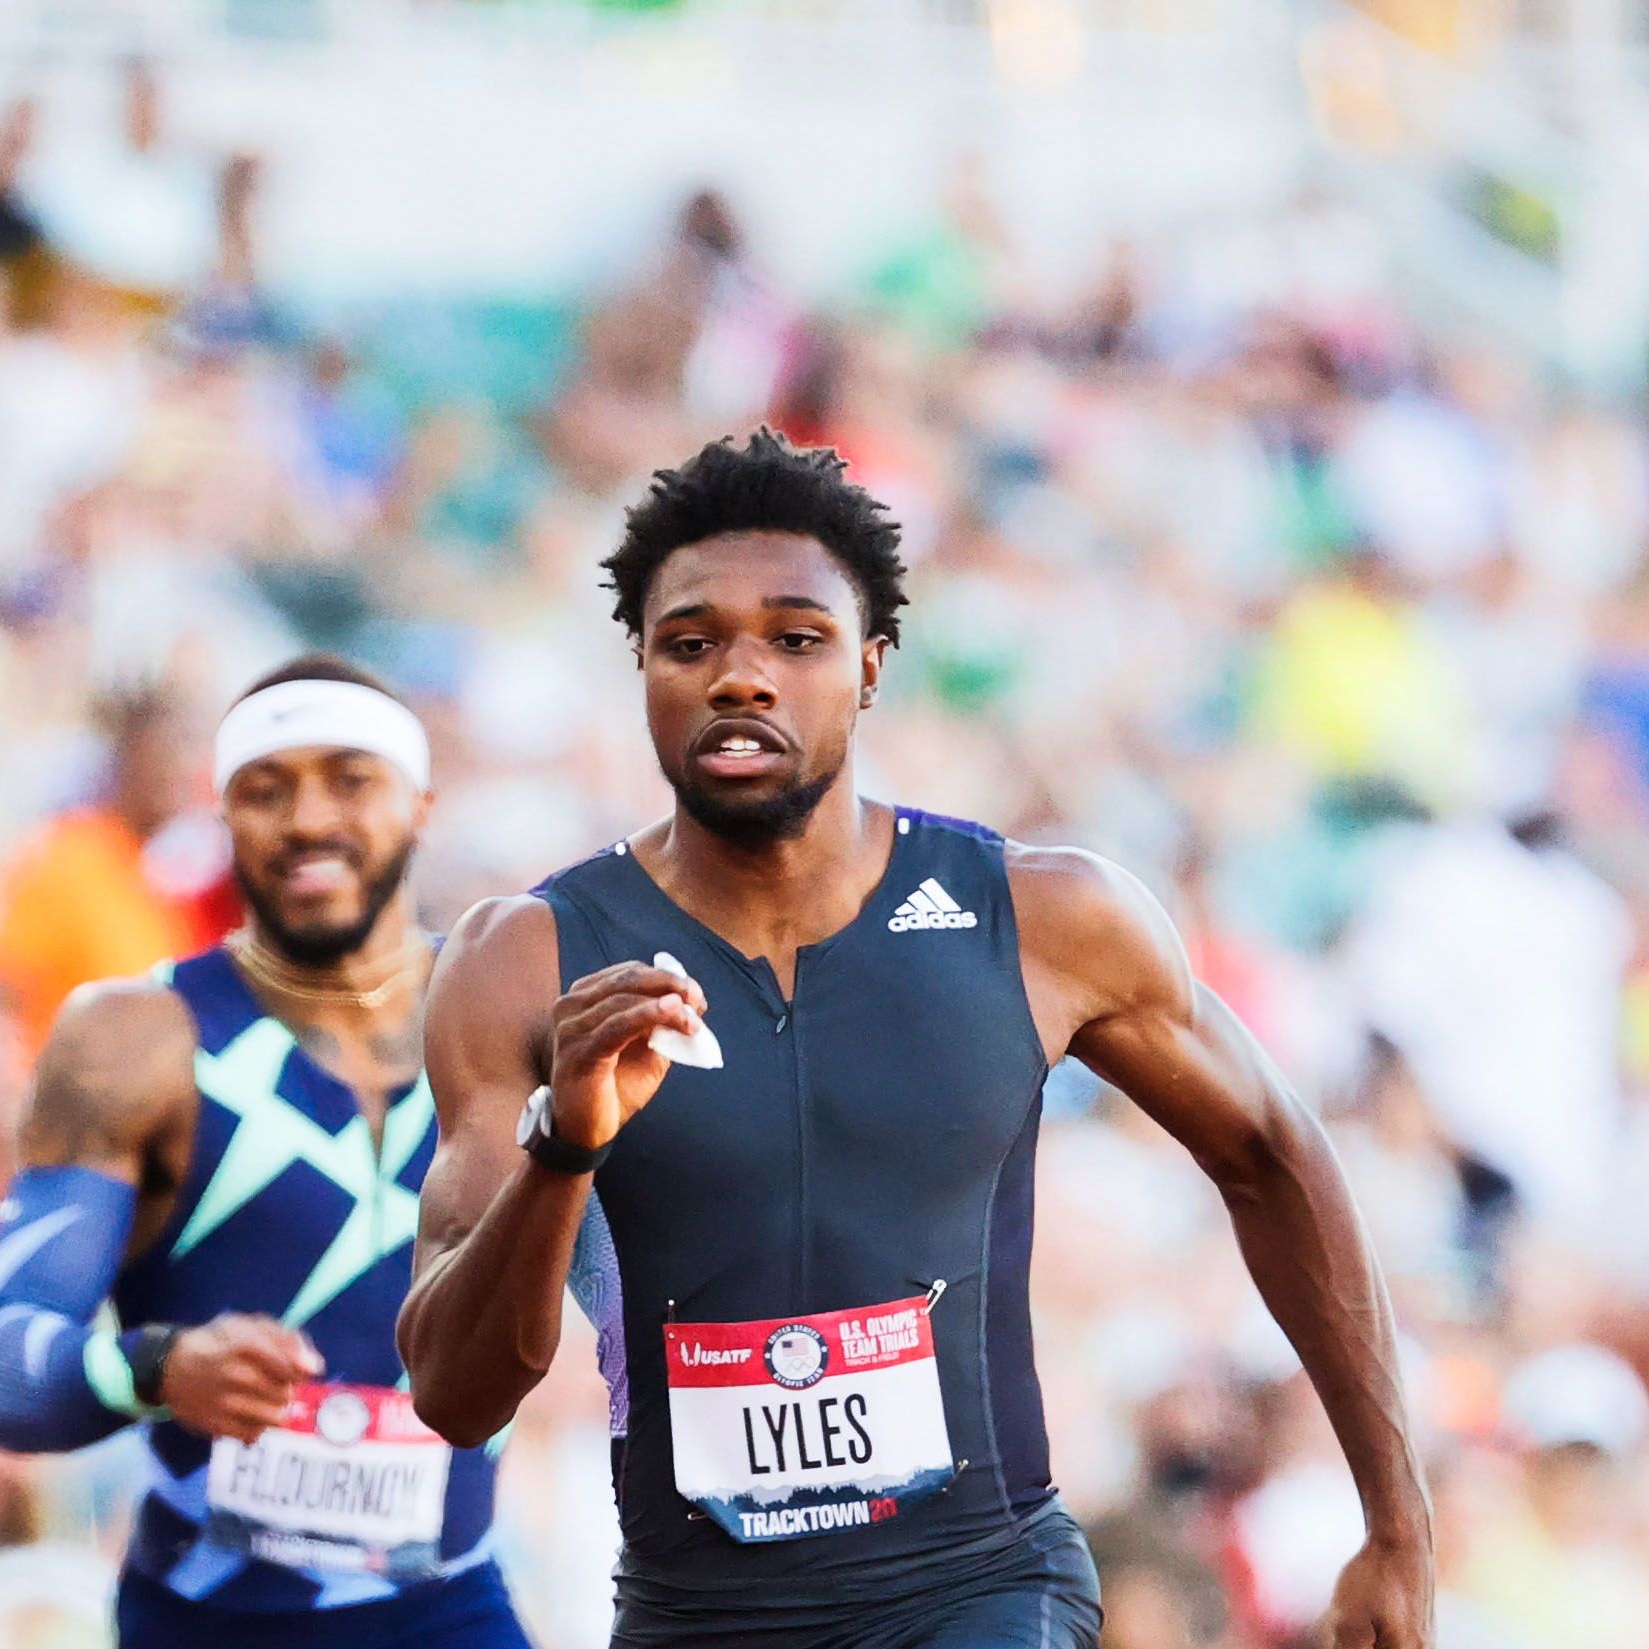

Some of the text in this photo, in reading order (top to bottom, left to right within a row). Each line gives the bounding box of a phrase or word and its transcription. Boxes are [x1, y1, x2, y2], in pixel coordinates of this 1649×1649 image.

[888, 911, 978, 932] adidas
[839, 1309, 917, 1341] U.S. OLYMPIC
[701, 1348, 752, 1365] USATF
[842, 1327, 919, 1359] TEAM TRIALS
[742, 1393, 872, 1475] LYLES
